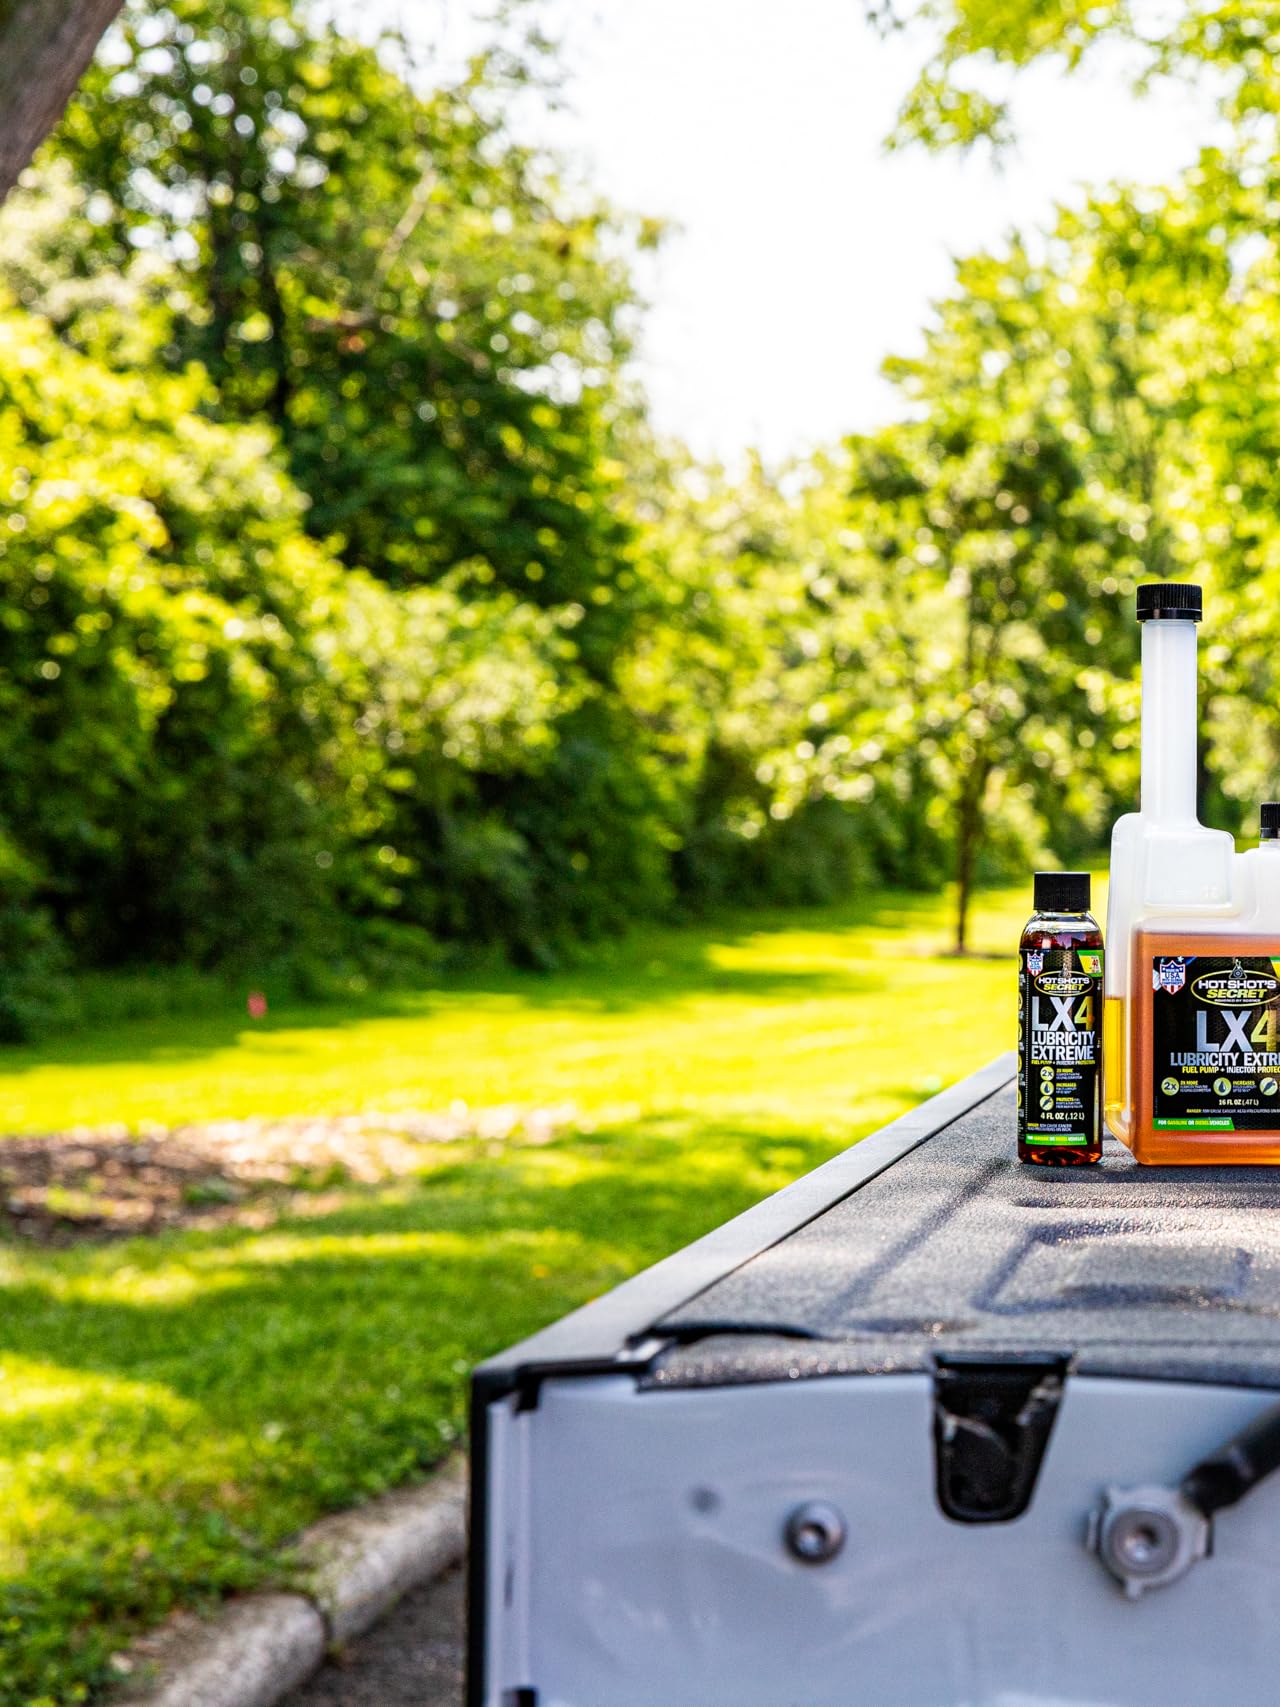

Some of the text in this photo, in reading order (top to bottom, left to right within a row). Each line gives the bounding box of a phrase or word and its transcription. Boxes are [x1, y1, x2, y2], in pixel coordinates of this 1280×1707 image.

[1198, 980, 1277, 989] HOT SHOT'S
[1206, 989, 1267, 998] SECRET
[1032, 996, 1094, 1031] LX4
[1032, 1031, 1095, 1045] LUBRICITY
[1196, 1010, 1280, 1052] LX4
[1031, 1045, 1094, 1060] EXTREME
[1170, 1052, 1239, 1066] LUBRICITY
[1040, 1112, 1045, 1120] 4
[1046, 1112, 1054, 1120] FL
[1055, 1112, 1064, 1120] OZ
[1065, 1112, 1078, 1120] (.12
